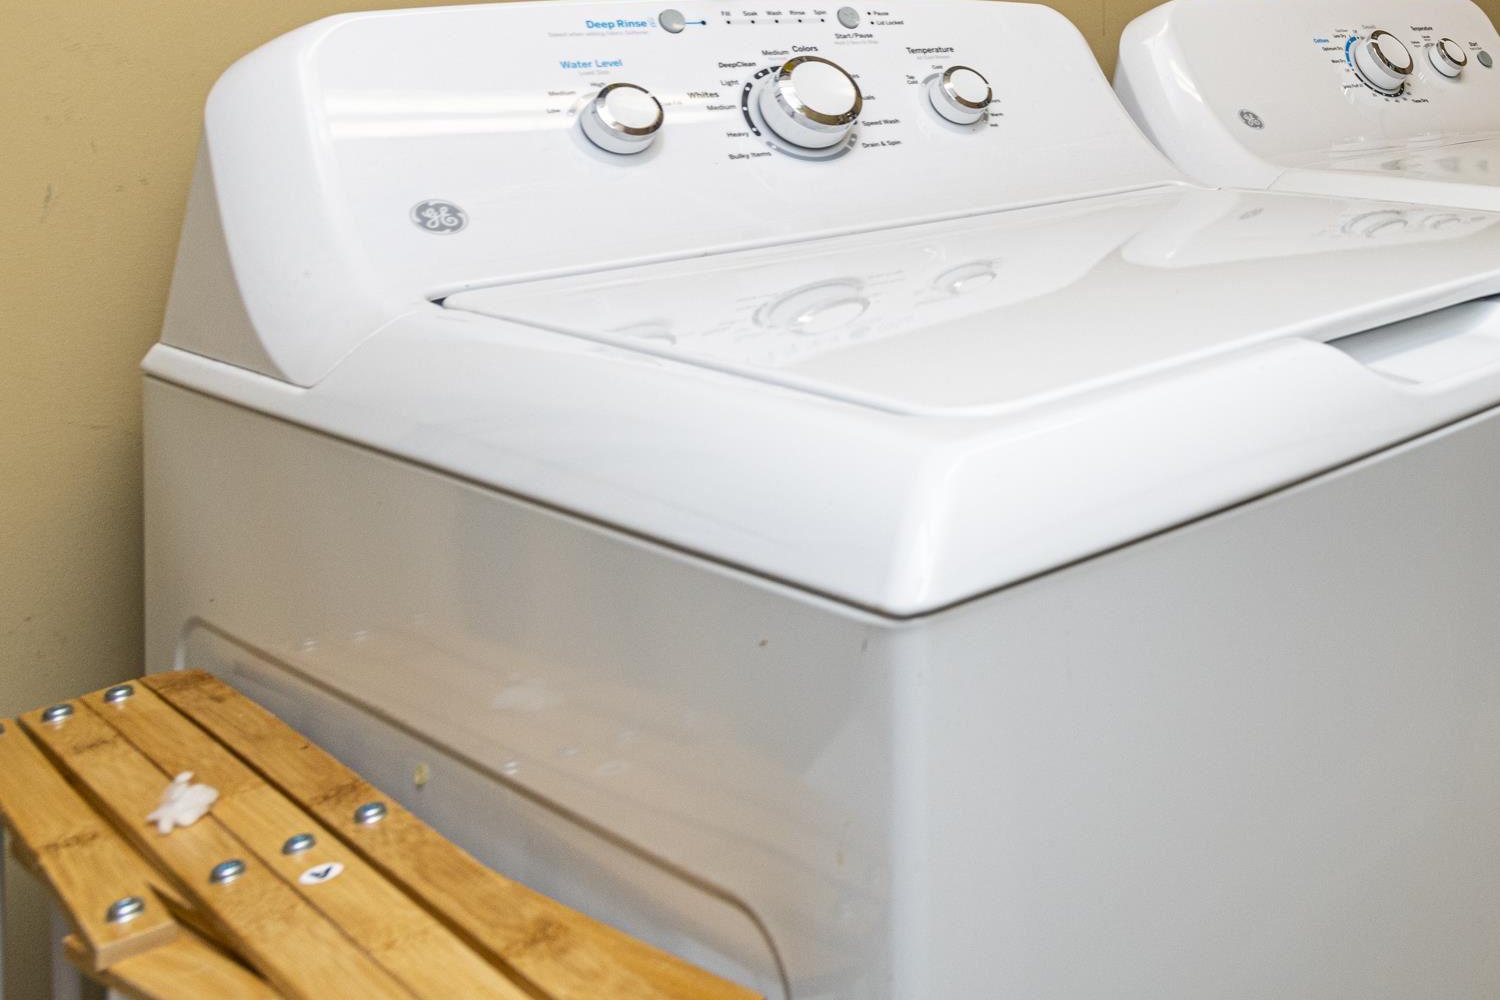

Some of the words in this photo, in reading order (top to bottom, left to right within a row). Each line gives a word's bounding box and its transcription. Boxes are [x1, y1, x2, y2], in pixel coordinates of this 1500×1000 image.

[585, 19, 615, 30] Deep
[617, 19, 648, 28] Rinse
[834, 32, 873, 40] Start/Pause
[761, 49, 789, 57] Medium
[791, 45, 819, 53] Colors
[905, 46, 954, 55] Temperature
[560, 60, 592, 70] Water
[594, 58, 624, 68] Level
[718, 61, 757, 70] DeepClean
[720, 79, 740, 87] Light
[687, 91, 720, 99] Whites
[726, 131, 750, 139] Heavy
[728, 152, 751, 161] Bulky
[751, 151, 772, 159] Items
